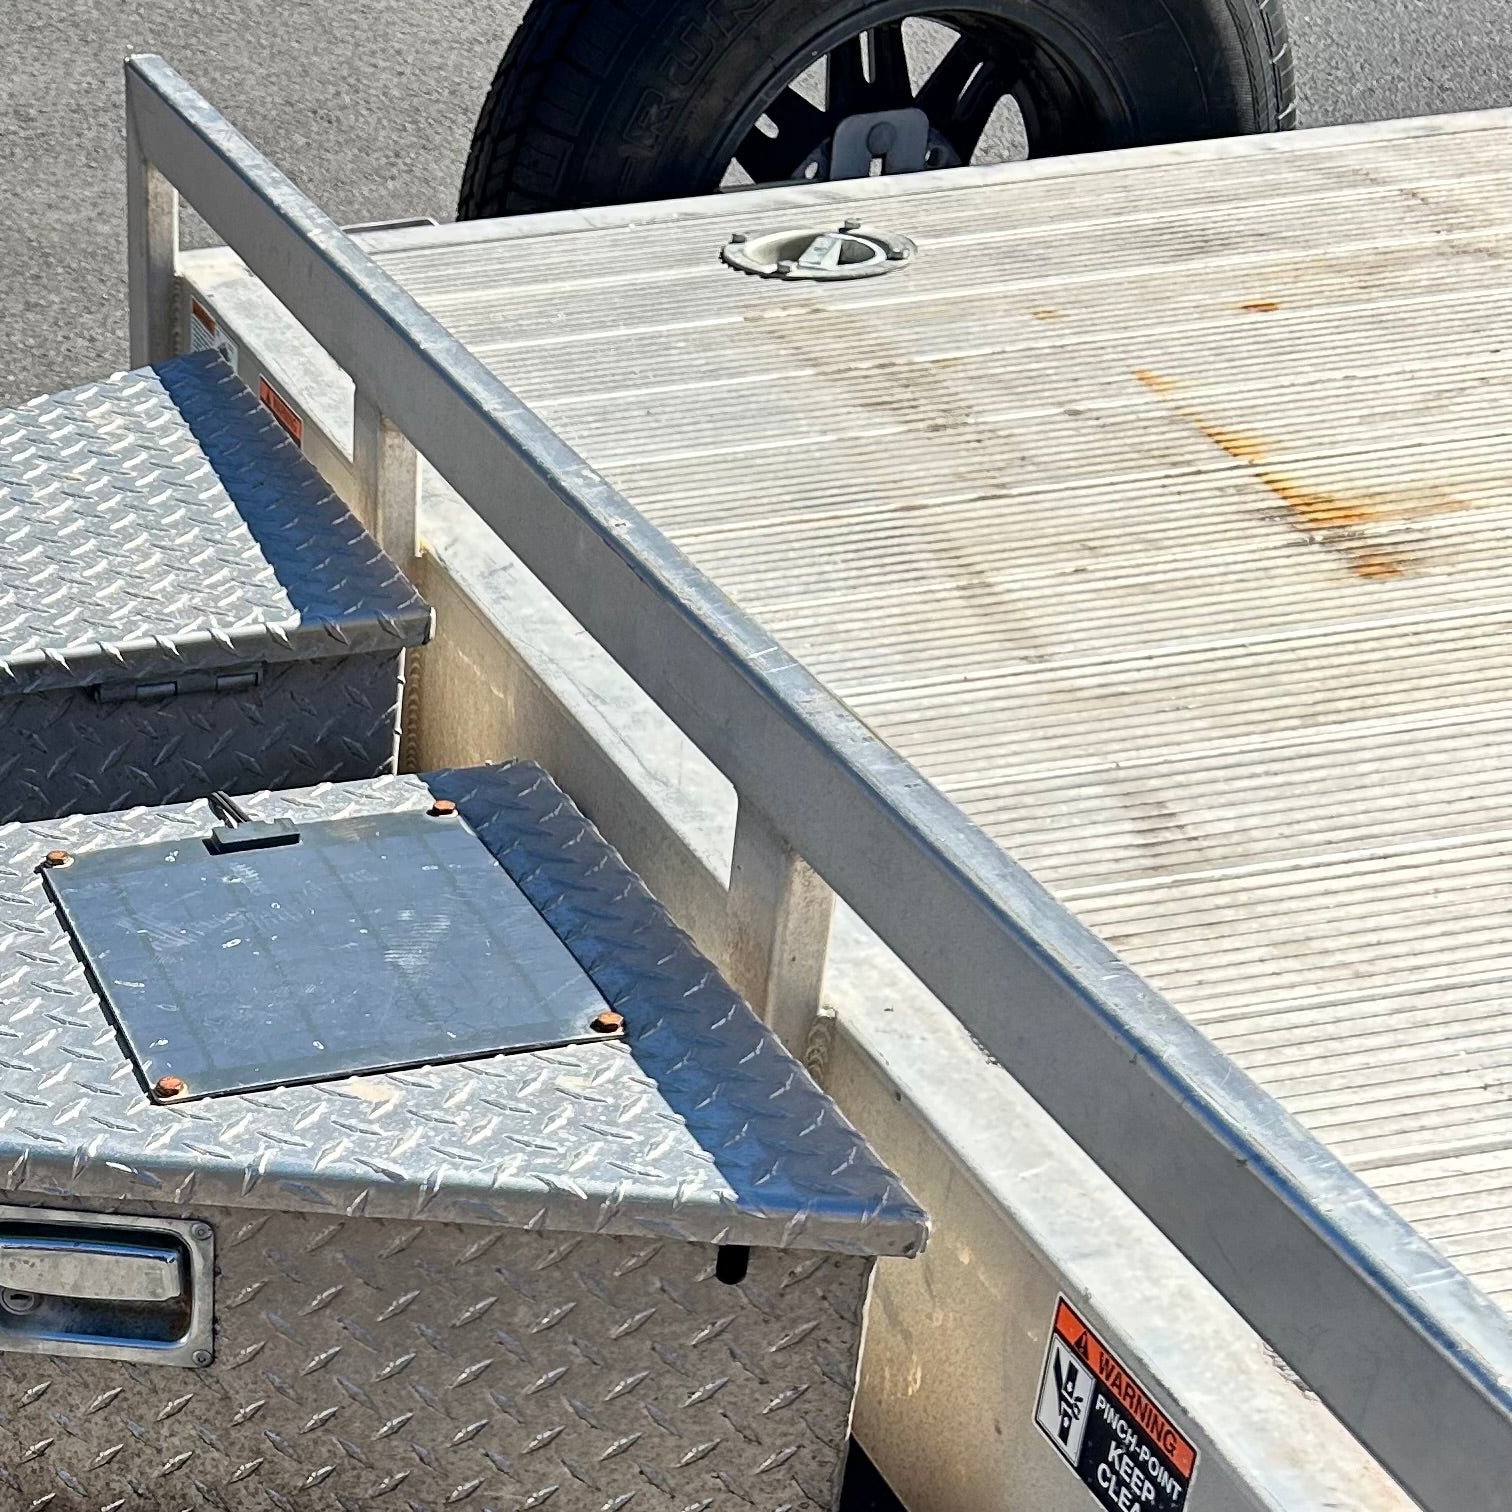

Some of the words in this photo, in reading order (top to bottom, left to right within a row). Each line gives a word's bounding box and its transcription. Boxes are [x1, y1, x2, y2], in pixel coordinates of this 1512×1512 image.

[1095, 1393, 1182, 1501] PINCH-POINT
[1098, 1351, 1178, 1458] WARNING
[1108, 1441, 1156, 1503] KEEP
